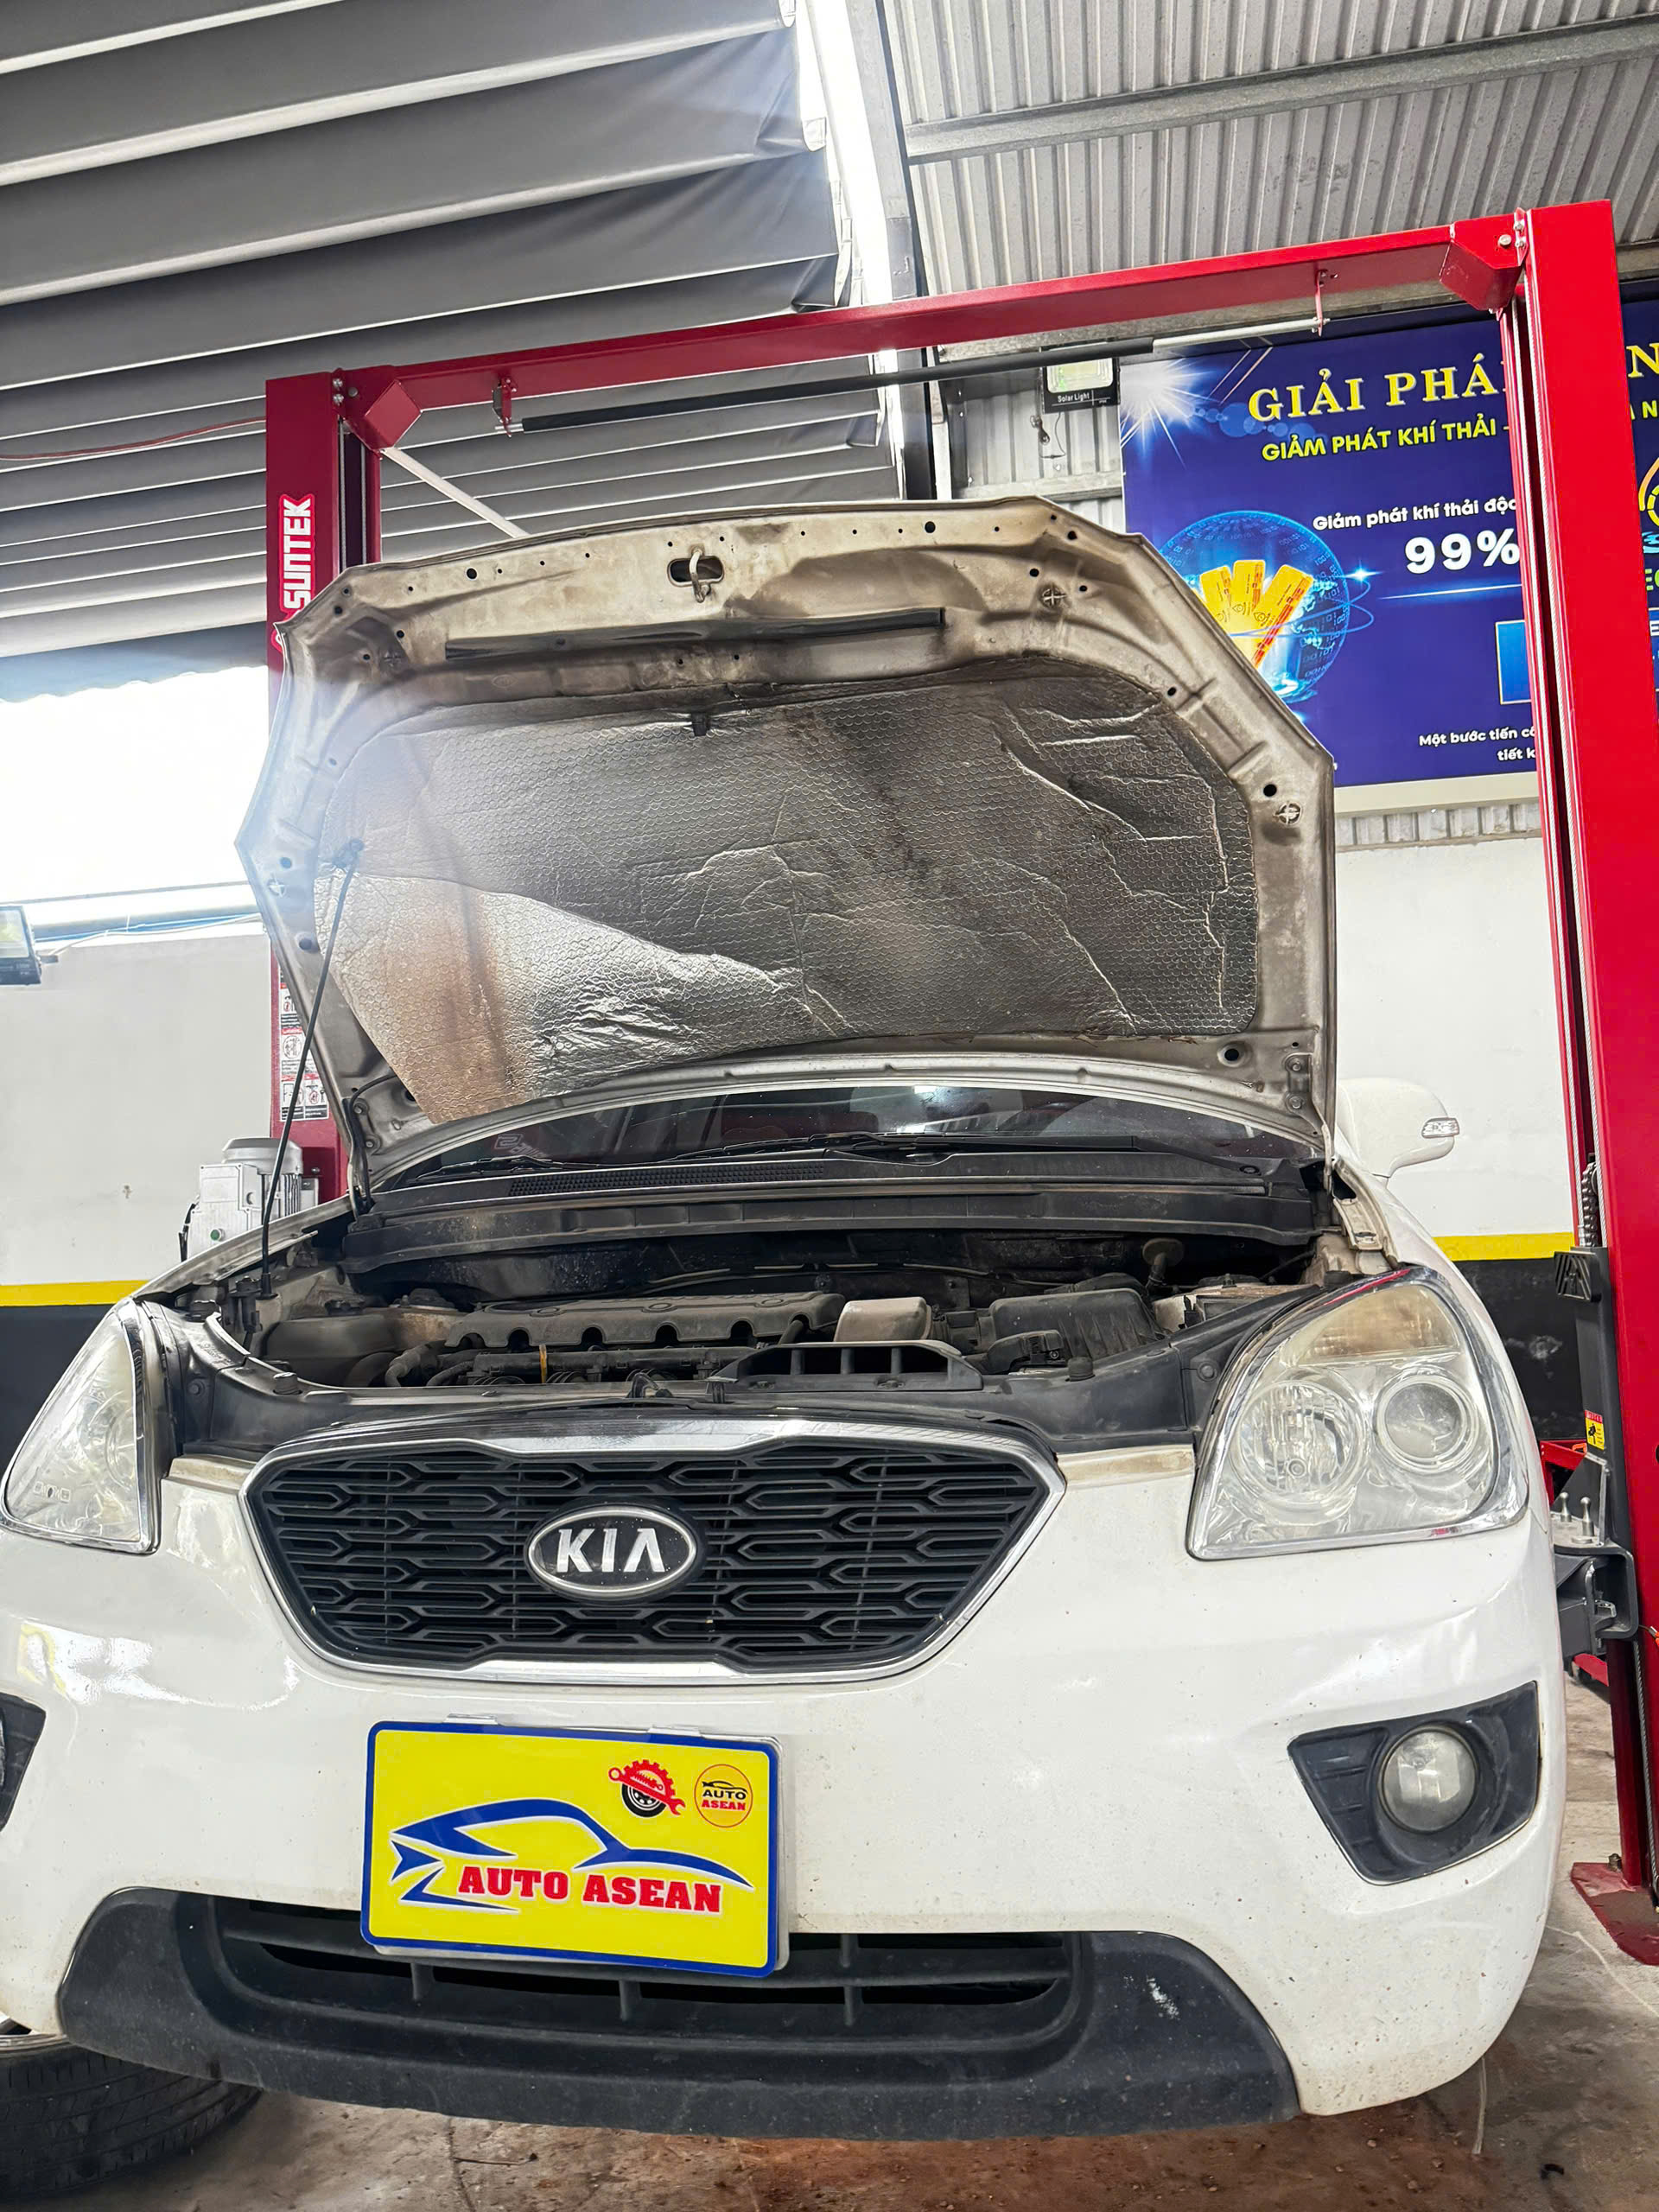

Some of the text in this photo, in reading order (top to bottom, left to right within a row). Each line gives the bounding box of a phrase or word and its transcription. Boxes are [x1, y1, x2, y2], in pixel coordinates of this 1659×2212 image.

[1248, 353, 1506, 422] GIẢI PHÁ
[1262, 413, 1497, 461] GIẢM PHÁT KHÍ THẢI
[1312, 512, 1362, 531] Giảm
[1366, 507, 1408, 528] phát
[1413, 502, 1440, 521] khí
[1443, 499, 1479, 518] thải
[283, 498, 312, 609] SUNTEK
[1405, 528, 1520, 575] 99%
[1419, 733, 1446, 747] Một
[1450, 729, 1486, 744] bước
[1489, 726, 1518, 741] tiến
[1497, 747, 1523, 761] tiết
[556, 1528, 665, 1573] KIA
[702, 1789, 747, 1800] AUTO
[702, 1799, 746, 1811] ASEAN
[458, 1866, 721, 1913] AUTO ASEAN
